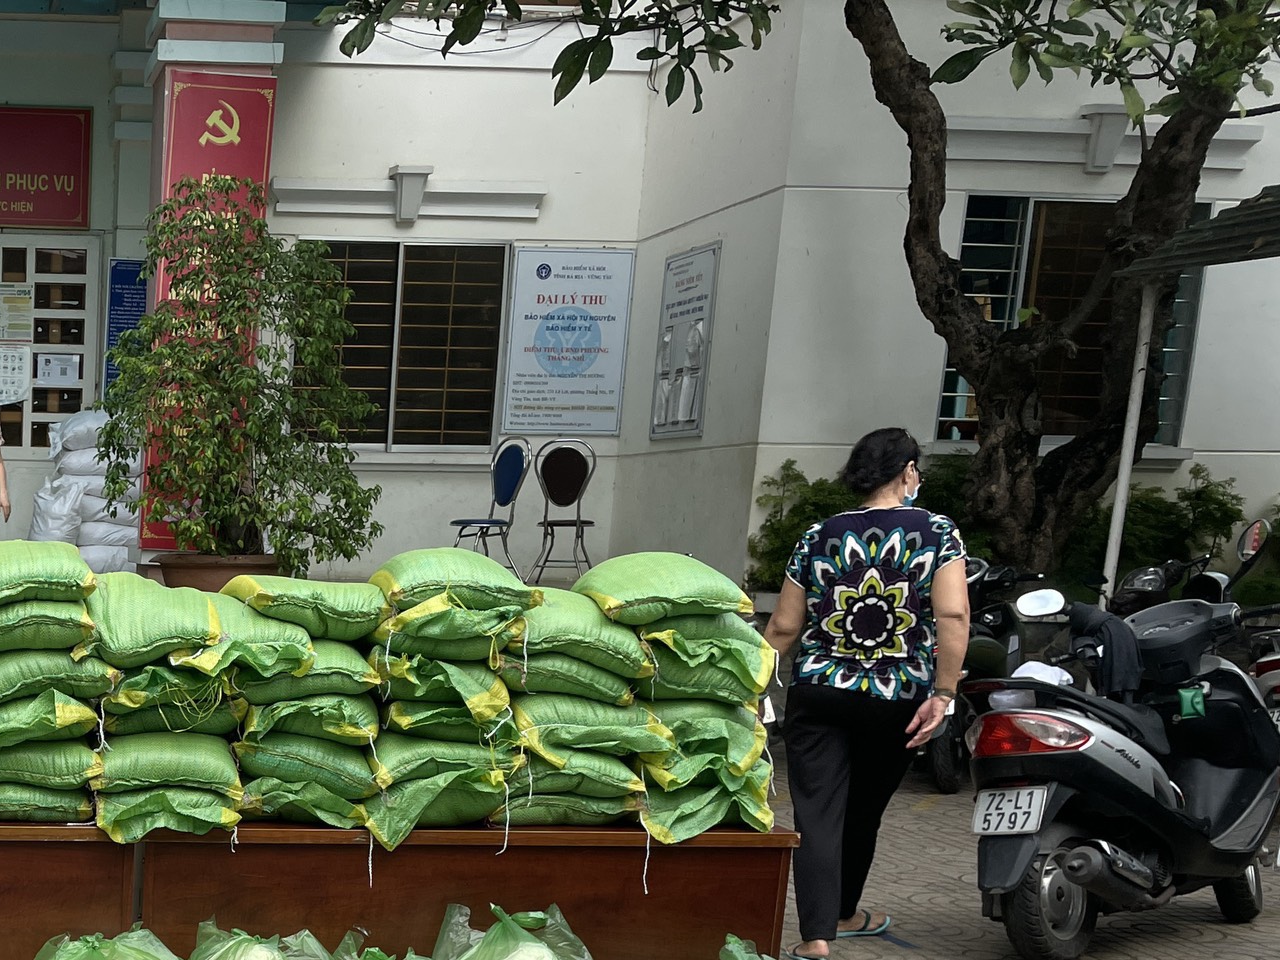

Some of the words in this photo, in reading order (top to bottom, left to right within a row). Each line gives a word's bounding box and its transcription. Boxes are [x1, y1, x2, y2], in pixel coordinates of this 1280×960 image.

[6, 174, 49, 195] PHỤC
[53, 175, 75, 196] VỤ
[11, 200, 33, 214] HIỆN
[536, 294, 558, 307] ĐẠI
[562, 292, 578, 305] LÝ
[581, 295, 607, 305] THU
[985, 790, 1034, 811] 72-L1
[981, 810, 1031, 831] 5797
